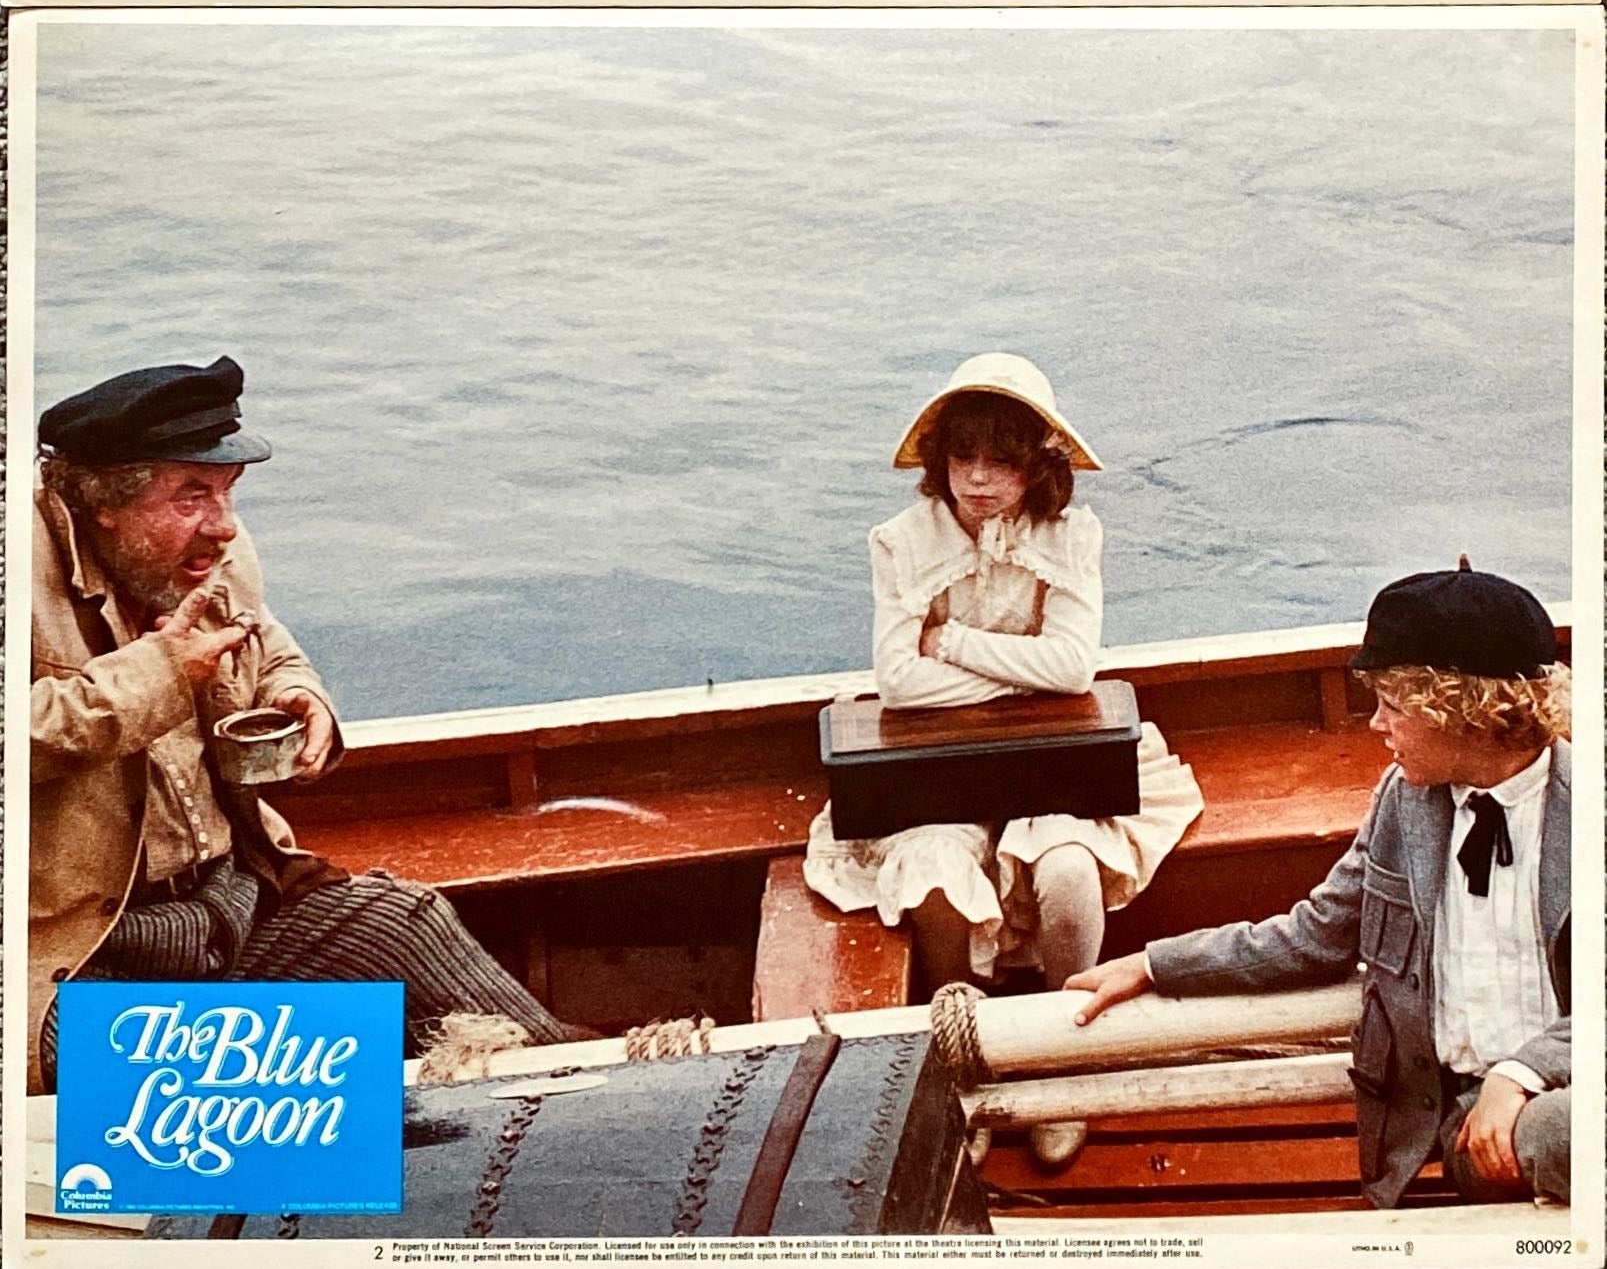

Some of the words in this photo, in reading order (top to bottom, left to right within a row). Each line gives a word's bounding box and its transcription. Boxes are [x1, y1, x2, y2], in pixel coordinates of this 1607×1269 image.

[109, 1001, 216, 1063] The
[193, 1004, 359, 1087] Blue
[105, 1068, 344, 1177] Lagoon
[60, 1191, 112, 1200] Columbia
[64, 1200, 109, 1209] Pictures
[392, 1242, 428, 1252] Property
[443, 1242, 479, 1250] National
[482, 1241, 511, 1250] Screen
[514, 1241, 546, 1250] Service
[548, 1241, 601, 1250] Corporation.
[604, 1241, 641, 1249] Licensed
[644, 1241, 656, 1249] for
[677, 1241, 695, 1250] only
[709, 1241, 755, 1249] connection
[779, 1240, 793, 1248] the
[796, 1240, 837, 1248] exhibition
[871, 1240, 900, 1248] picture
[931, 1239, 961, 1247] theatre
[964, 1239, 1001, 1248] licensing
[1064, 1238, 1100, 1246] Licensee
[1103, 1239, 1130, 1247] agrees
[1133, 1238, 1147, 1246] not
[1160, 1238, 1184, 1247] trade,
[1188, 1238, 1203, 1246] sell
[1516, 1240, 1571, 1254] 800092
[374, 1246, 383, 1260] 2
[404, 1253, 421, 1263] give
[433, 1254, 458, 1262] away,
[473, 1253, 501, 1262] permit
[504, 1253, 530, 1261] others
[562, 1253, 571, 1262] it,
[592, 1252, 612, 1260] shall
[614, 1252, 648, 1260] licensee
[711, 1253, 726, 1261] any
[729, 1251, 753, 1260] credit
[756, 1252, 777, 1261] upon
[780, 1251, 806, 1259] return
[821, 1251, 836, 1259] this
[841, 1251, 878, 1259] material.
[942, 1250, 966, 1258] either
[971, 1250, 991, 1258] must
[1009, 1250, 1045, 1258] returned
[1061, 1250, 1102, 1259] destroyed
[1106, 1249, 1157, 1258] immediately
[1162, 1249, 1181, 1257] after
